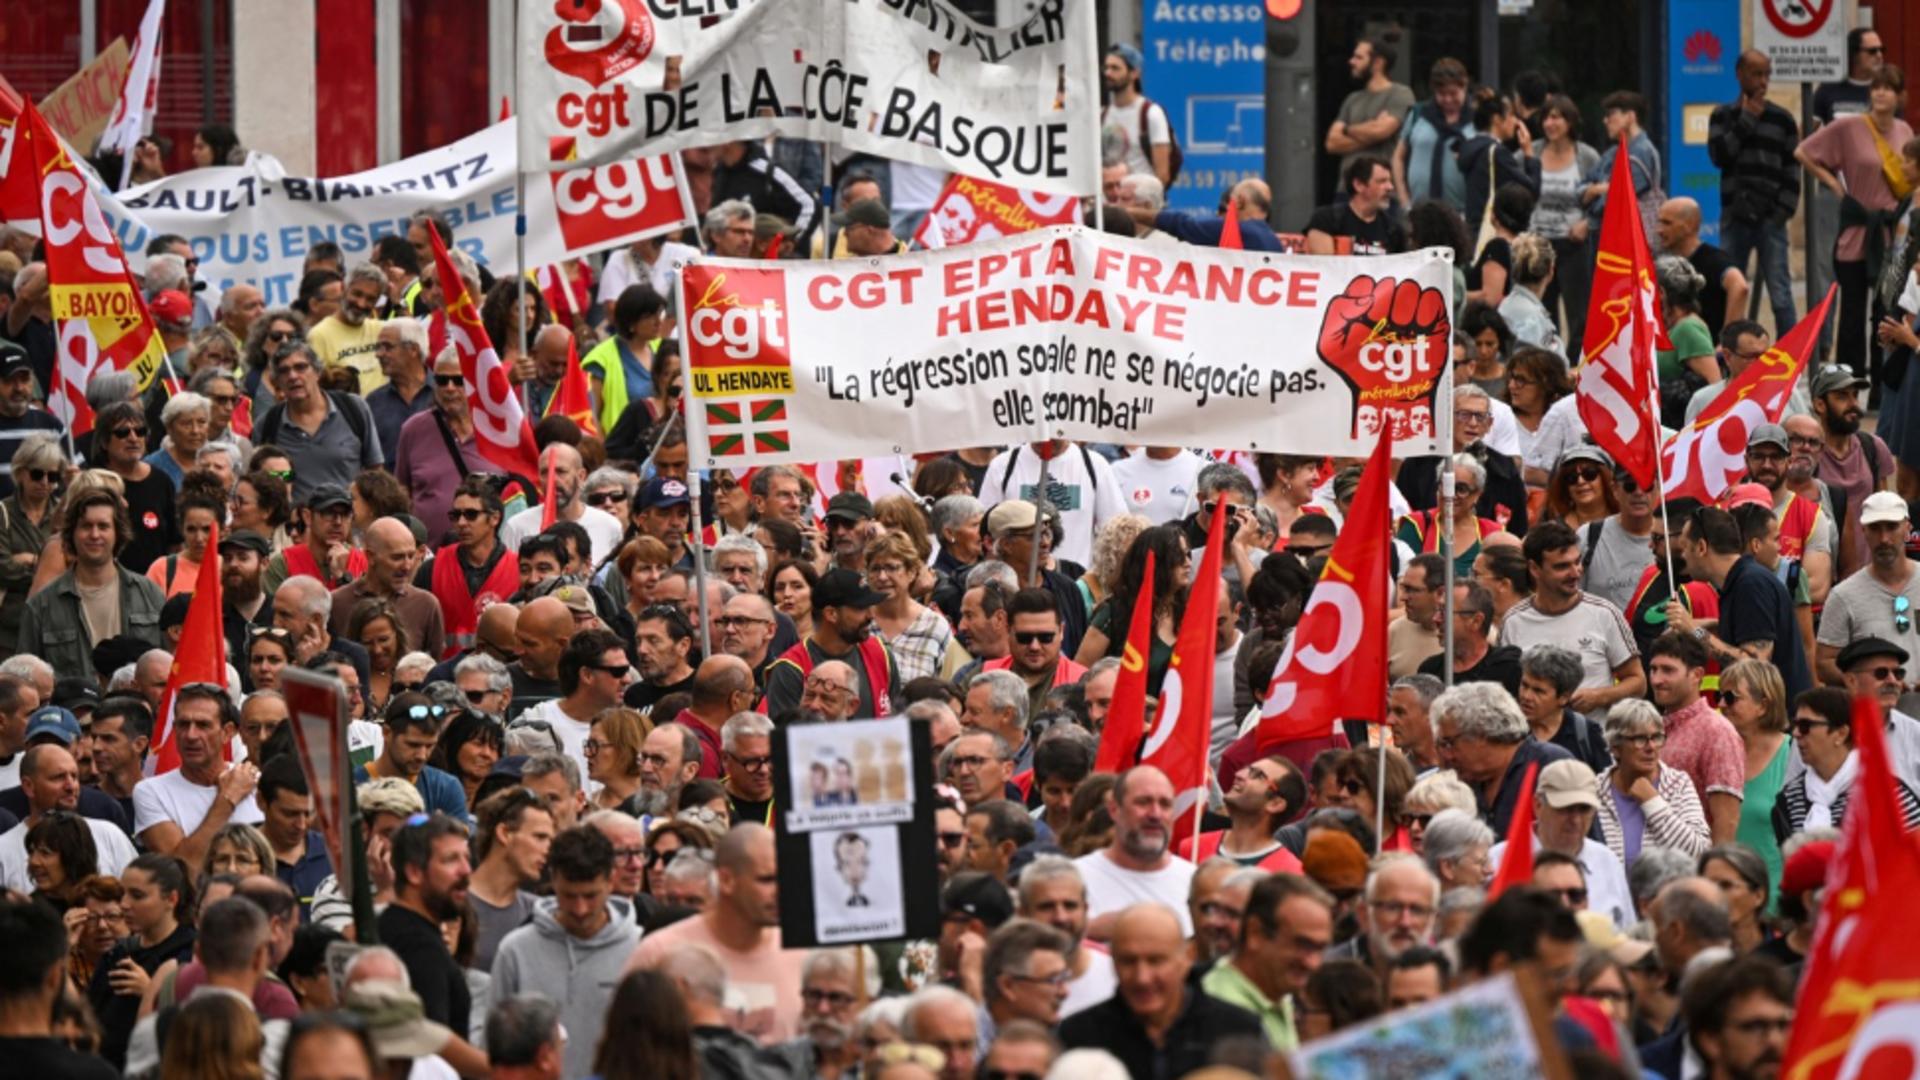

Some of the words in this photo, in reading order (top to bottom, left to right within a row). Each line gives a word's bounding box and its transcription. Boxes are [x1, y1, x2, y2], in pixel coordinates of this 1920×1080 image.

[1154, 0, 1262, 22] Accesso
[1155, 38, 1266, 67] Télépho
[556, 83, 630, 137] cgt
[644, 82, 699, 139] DE
[721, 67, 784, 123] LA
[880, 86, 1068, 178] BASQUE
[807, 267, 923, 312] CGT
[1093, 247, 1321, 308] FRANCE
[690, 297, 785, 359] cgt
[936, 283, 1187, 341] HENDAYE
[694, 373, 714, 393] UL
[717, 371, 792, 392] HENDAYE
[870, 347, 1009, 408] régression
[1085, 346, 1116, 380] ne
[1126, 351, 1155, 386] se
[1163, 352, 1260, 408] négocie
[1270, 368, 1327, 404] pas.
[1358, 334, 1431, 383] cgt
[993, 388, 1035, 428] elle
